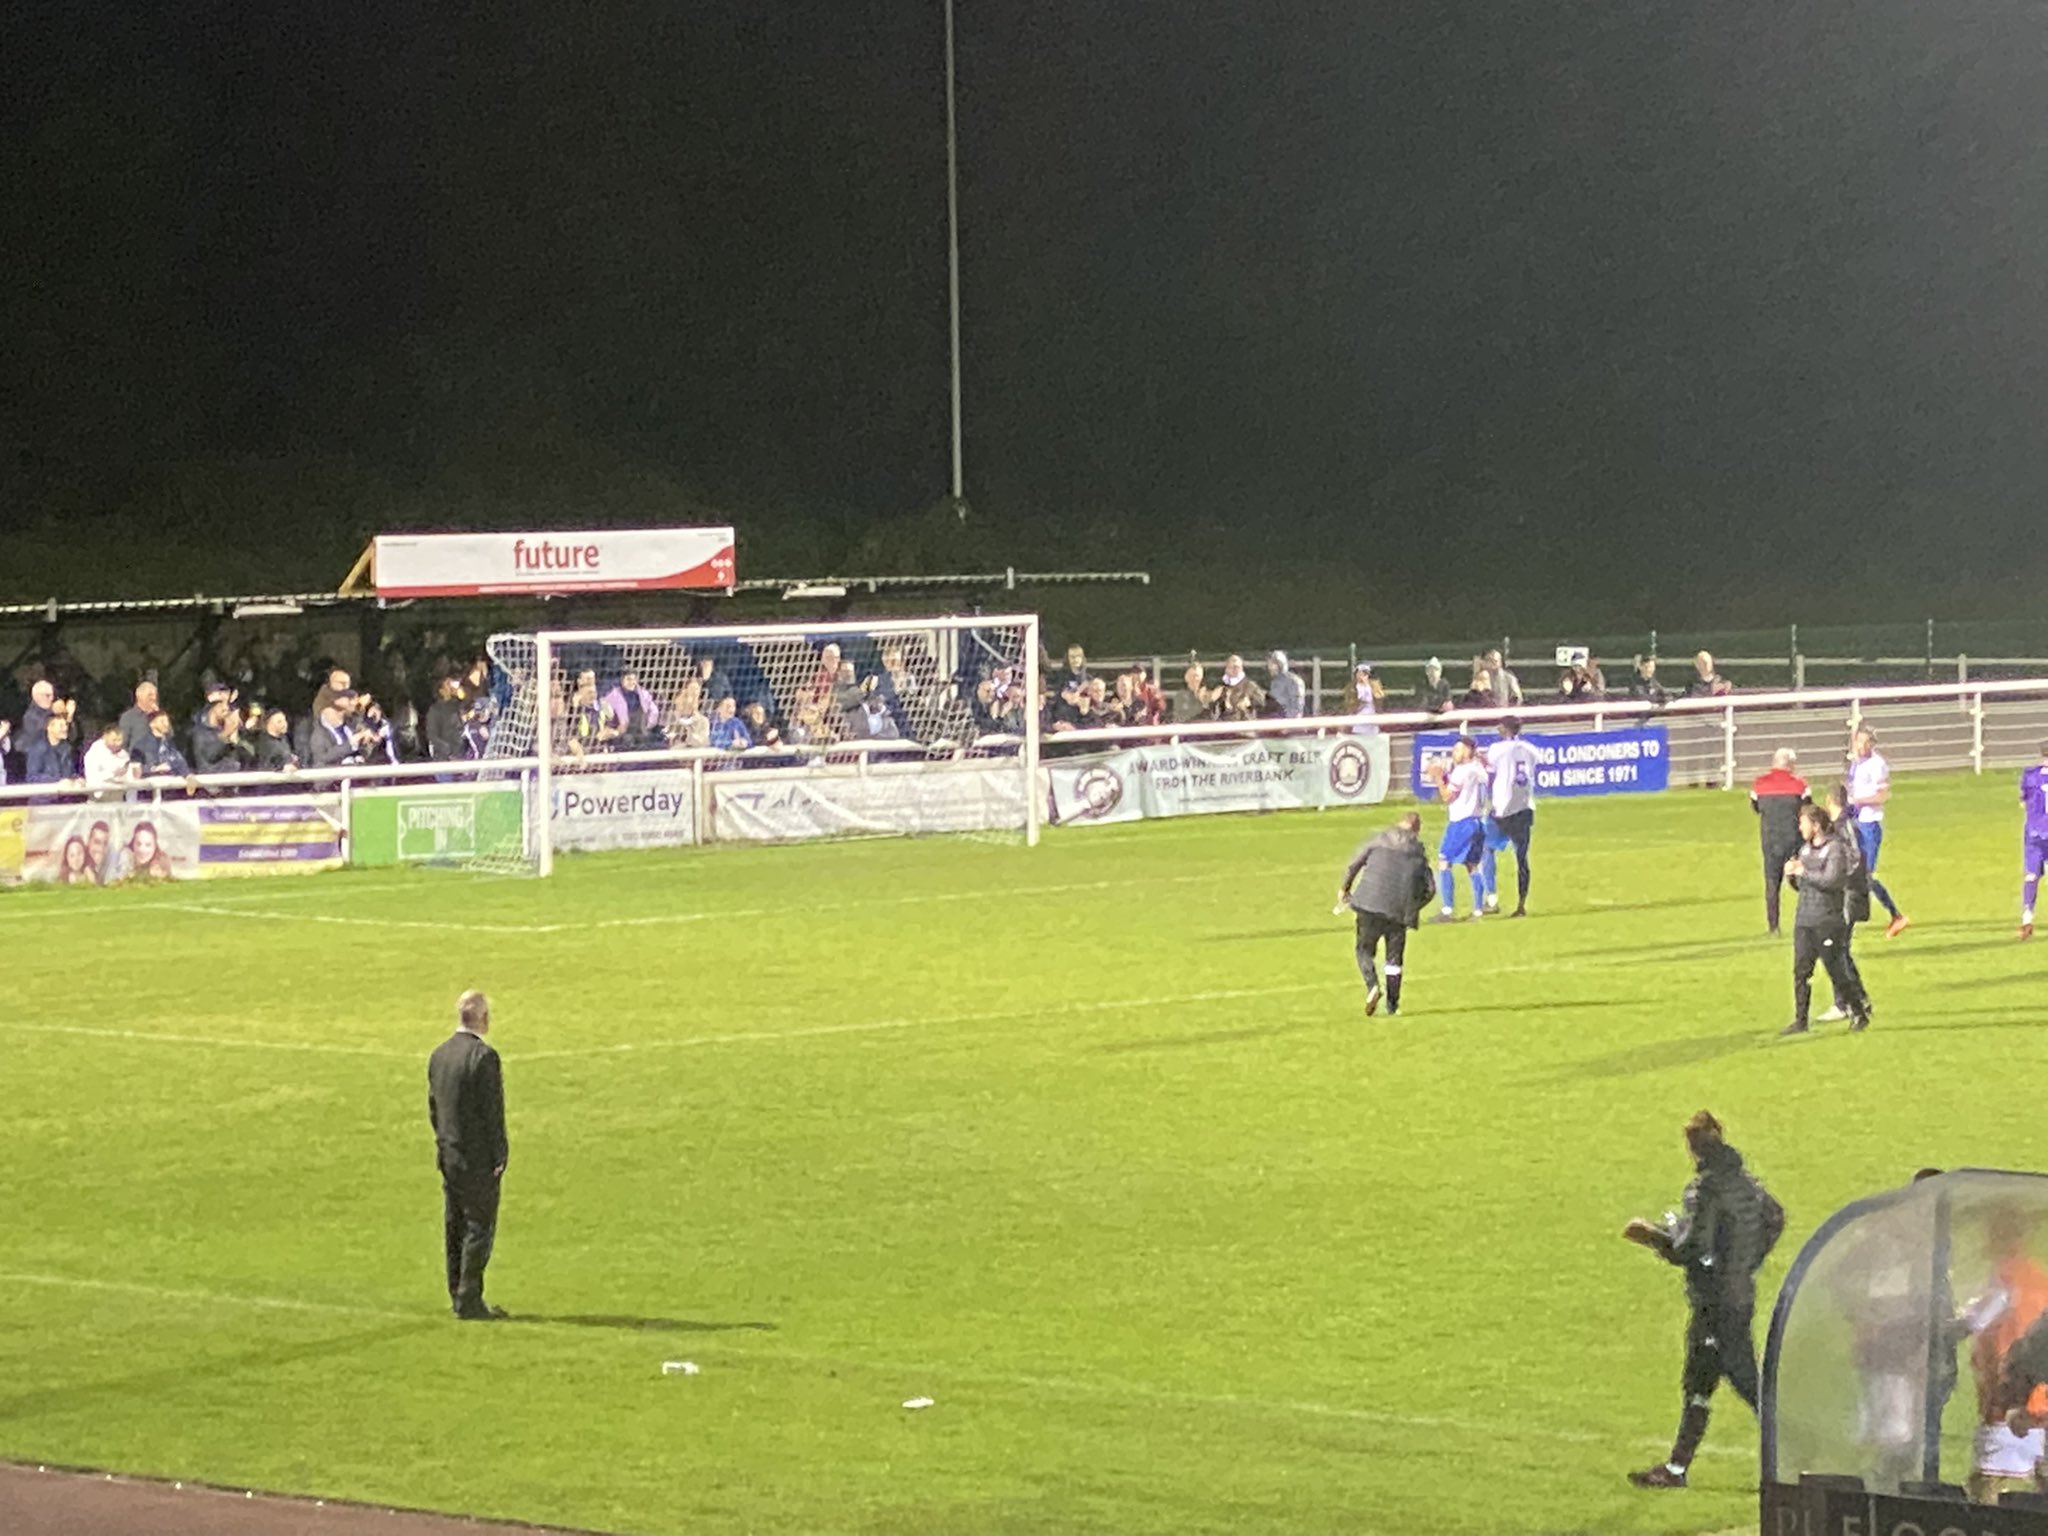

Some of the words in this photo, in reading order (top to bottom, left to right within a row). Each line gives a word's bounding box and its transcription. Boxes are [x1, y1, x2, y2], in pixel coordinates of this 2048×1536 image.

[514, 540, 600, 568] future
[1242, 751, 1284, 766] CRAFT
[1558, 742, 1640, 764] LONDONERS
[1641, 740, 1660, 758] TO
[1191, 772, 1216, 787] THE
[1220, 769, 1294, 785] RIVERBANK
[1563, 767, 1605, 786] SINCE
[1609, 766, 1638, 782] 1971
[565, 787, 683, 818] Powerday
